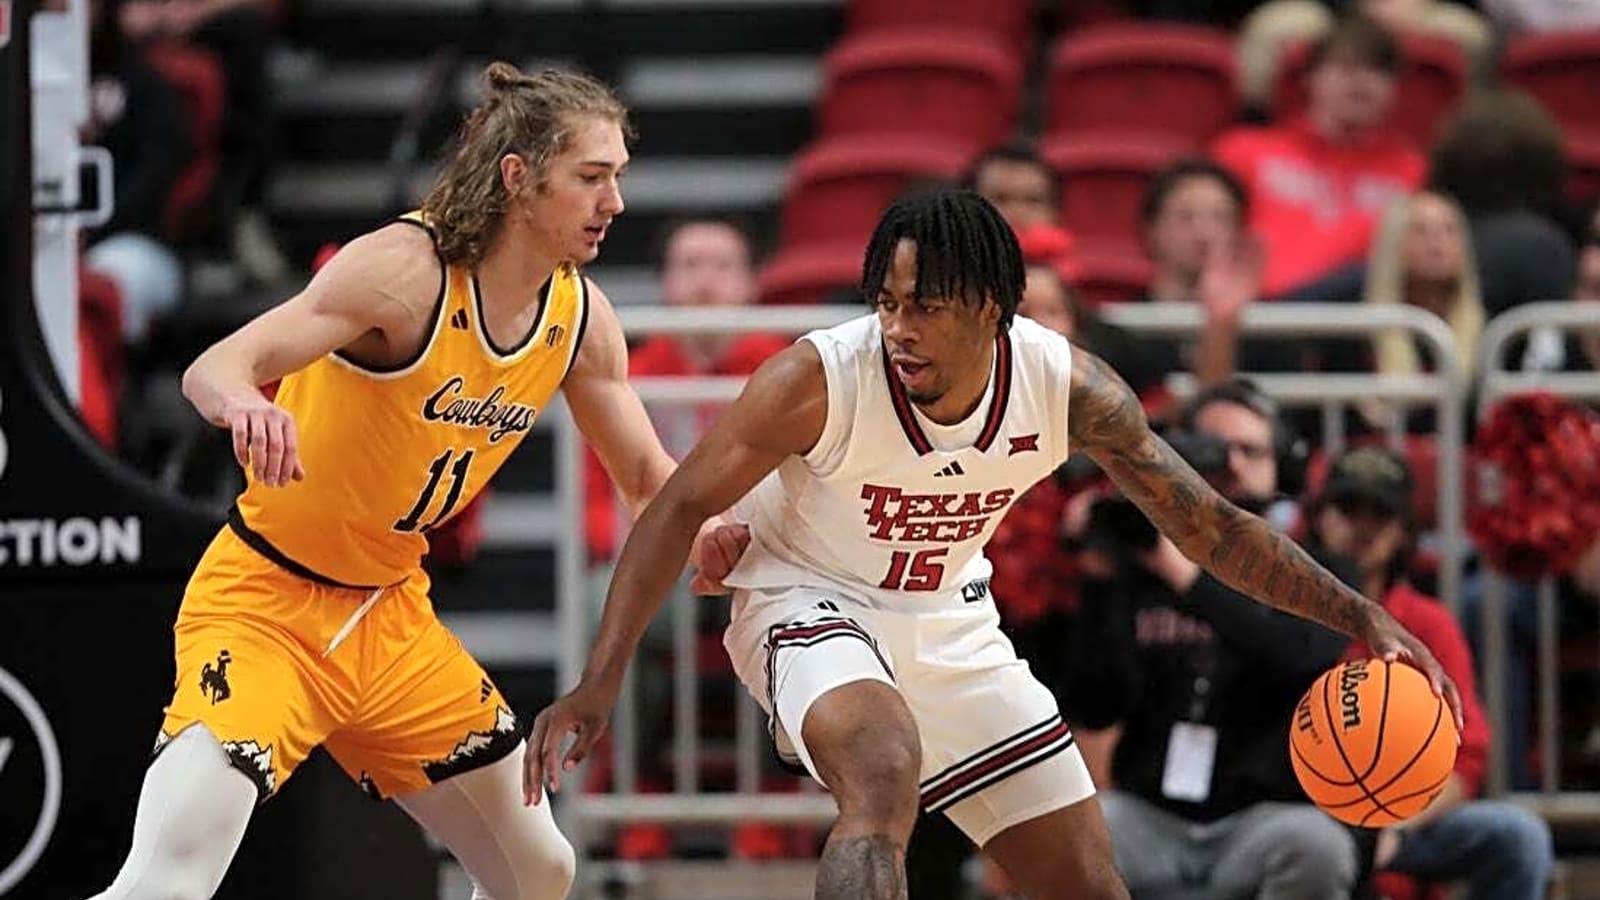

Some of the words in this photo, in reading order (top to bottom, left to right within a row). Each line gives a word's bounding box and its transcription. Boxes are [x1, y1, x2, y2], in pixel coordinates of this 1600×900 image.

[422, 376, 537, 443] Cowboys
[392, 448, 475, 534] 11
[860, 483, 1015, 528] TEXAS
[0, 516, 141, 566] TION
[869, 514, 991, 543] TECH
[878, 547, 950, 592] 15
[1341, 660, 1370, 733] ilson
